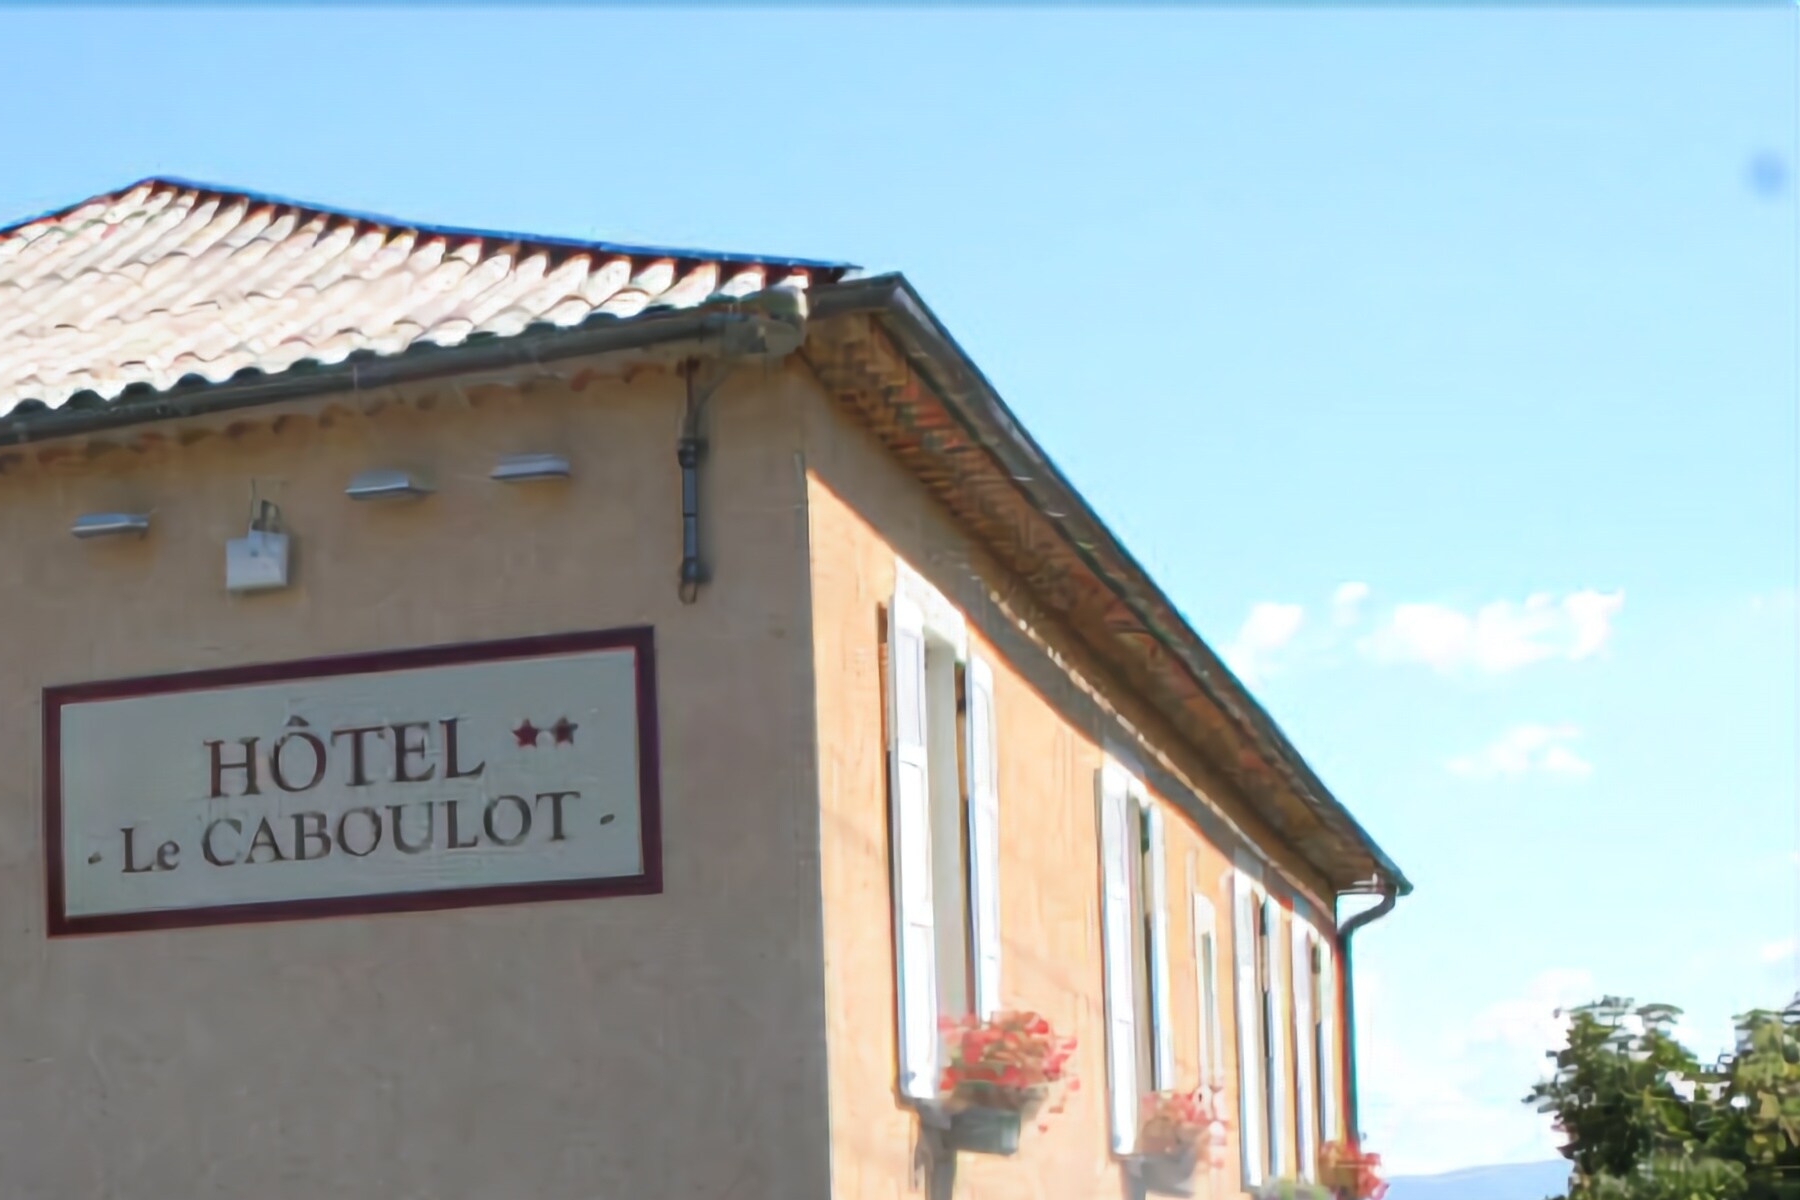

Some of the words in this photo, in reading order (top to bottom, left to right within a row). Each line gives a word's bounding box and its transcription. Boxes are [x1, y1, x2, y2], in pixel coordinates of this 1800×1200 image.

[203, 715, 486, 799] HÔTEL
[119, 826, 181, 874] Le
[201, 791, 581, 867] CABOULOT
